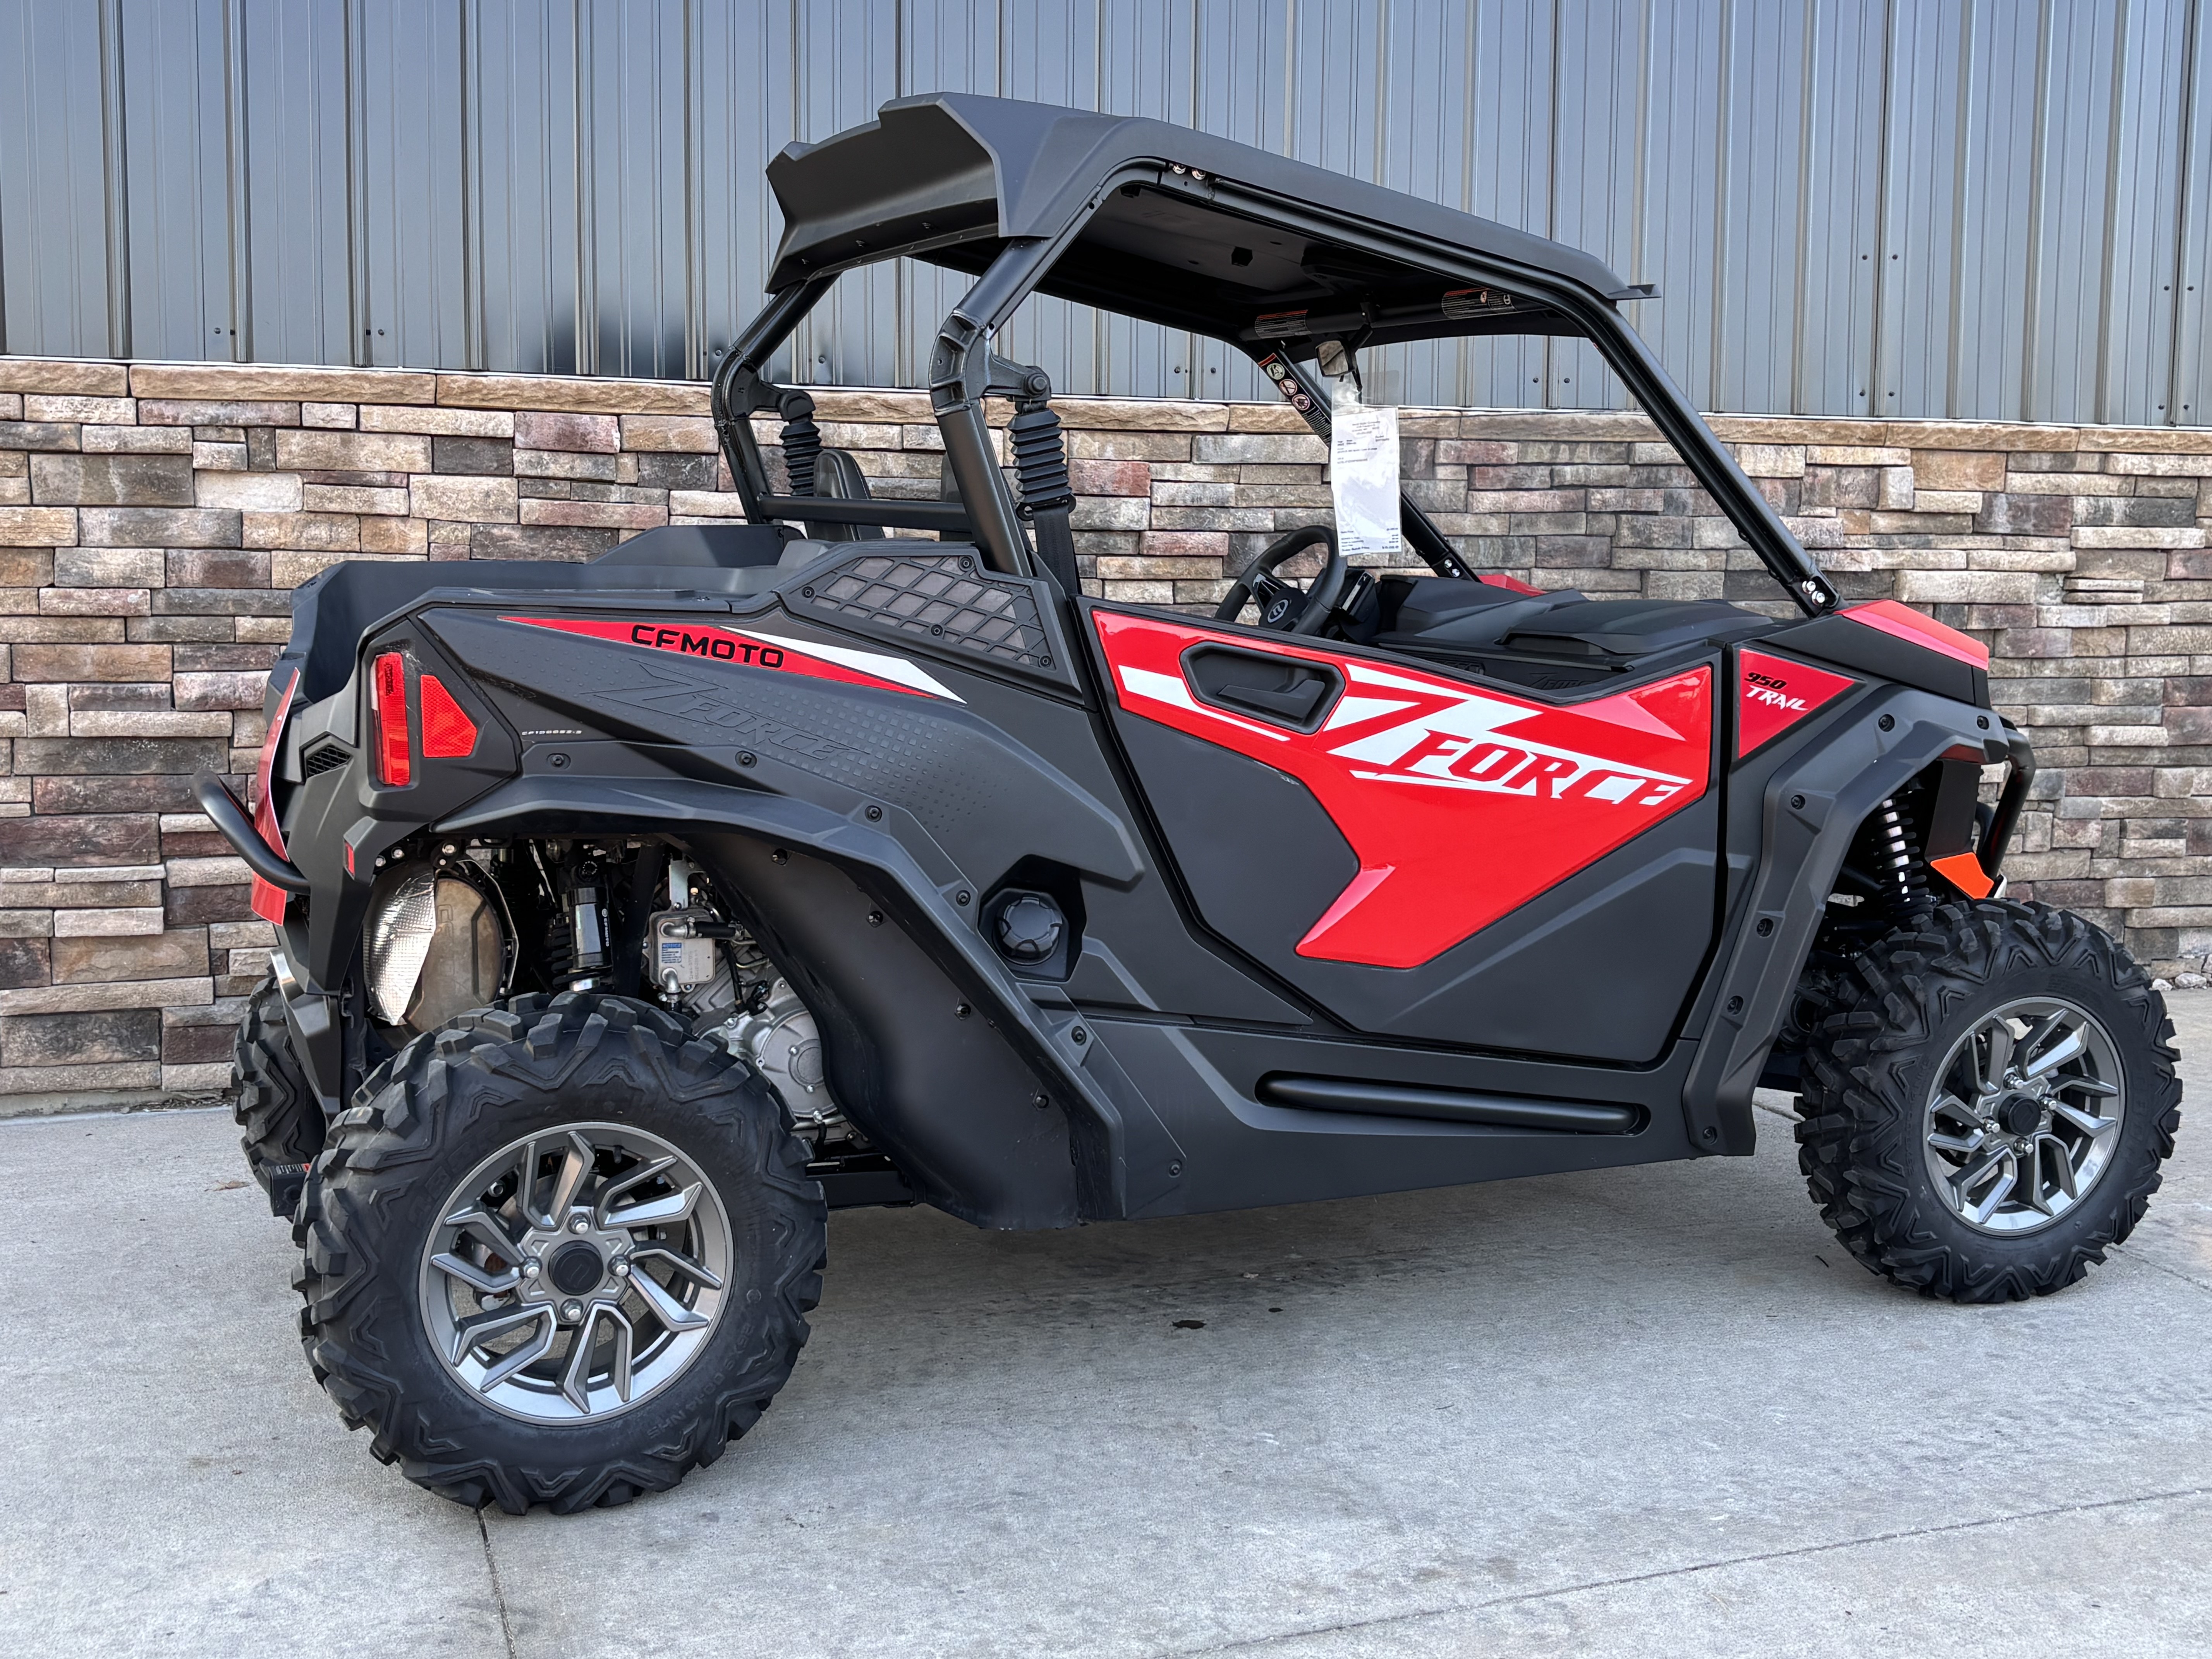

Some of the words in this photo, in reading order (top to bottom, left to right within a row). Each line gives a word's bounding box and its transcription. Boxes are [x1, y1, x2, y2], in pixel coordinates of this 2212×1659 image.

[631, 625, 784, 668] CFMOTO
[1744, 672, 1787, 689] 950
[1746, 685, 1809, 711] TRAIL
